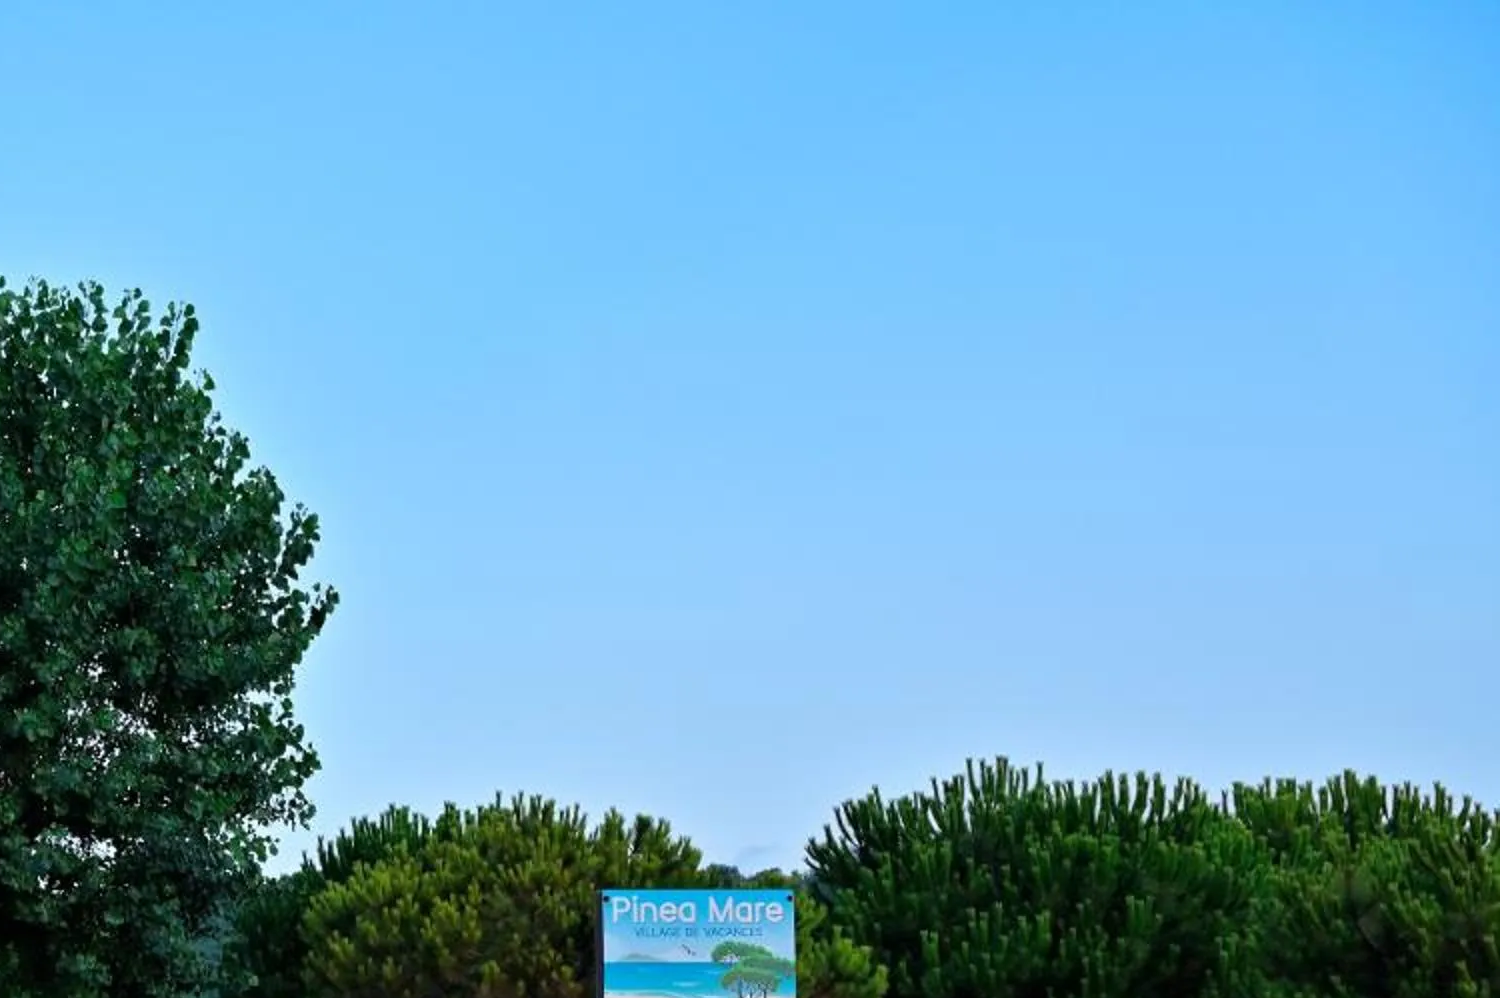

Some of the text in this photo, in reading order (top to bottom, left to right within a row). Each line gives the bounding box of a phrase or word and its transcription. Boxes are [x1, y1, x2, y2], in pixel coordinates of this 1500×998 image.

[611, 896, 785, 924] Pinea Mare
[633, 926, 764, 938] VILLAGE DE VACANCES
